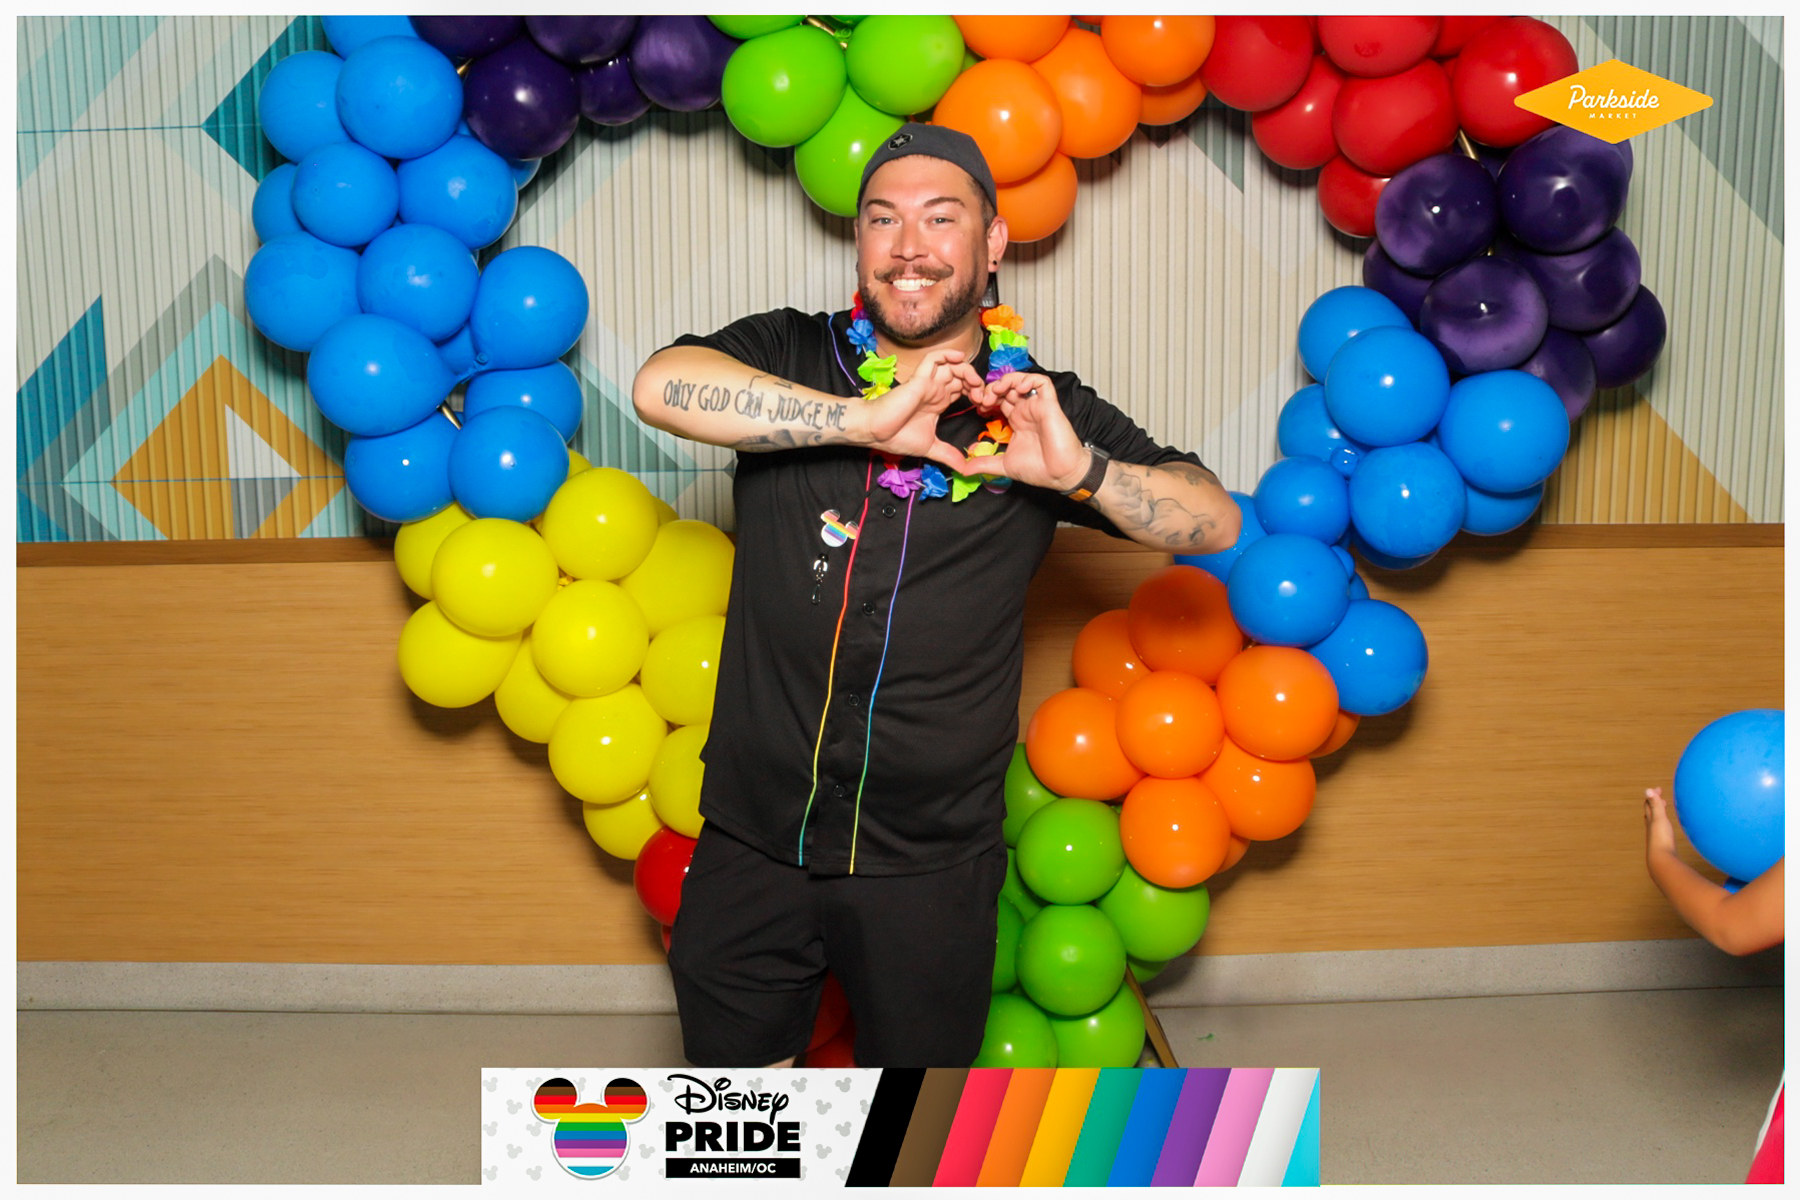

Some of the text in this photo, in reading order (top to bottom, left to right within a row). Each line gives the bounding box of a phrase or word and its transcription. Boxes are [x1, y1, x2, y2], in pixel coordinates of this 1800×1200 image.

[663, 378, 848, 432] ONLY GOD CAN JUDGE ME
